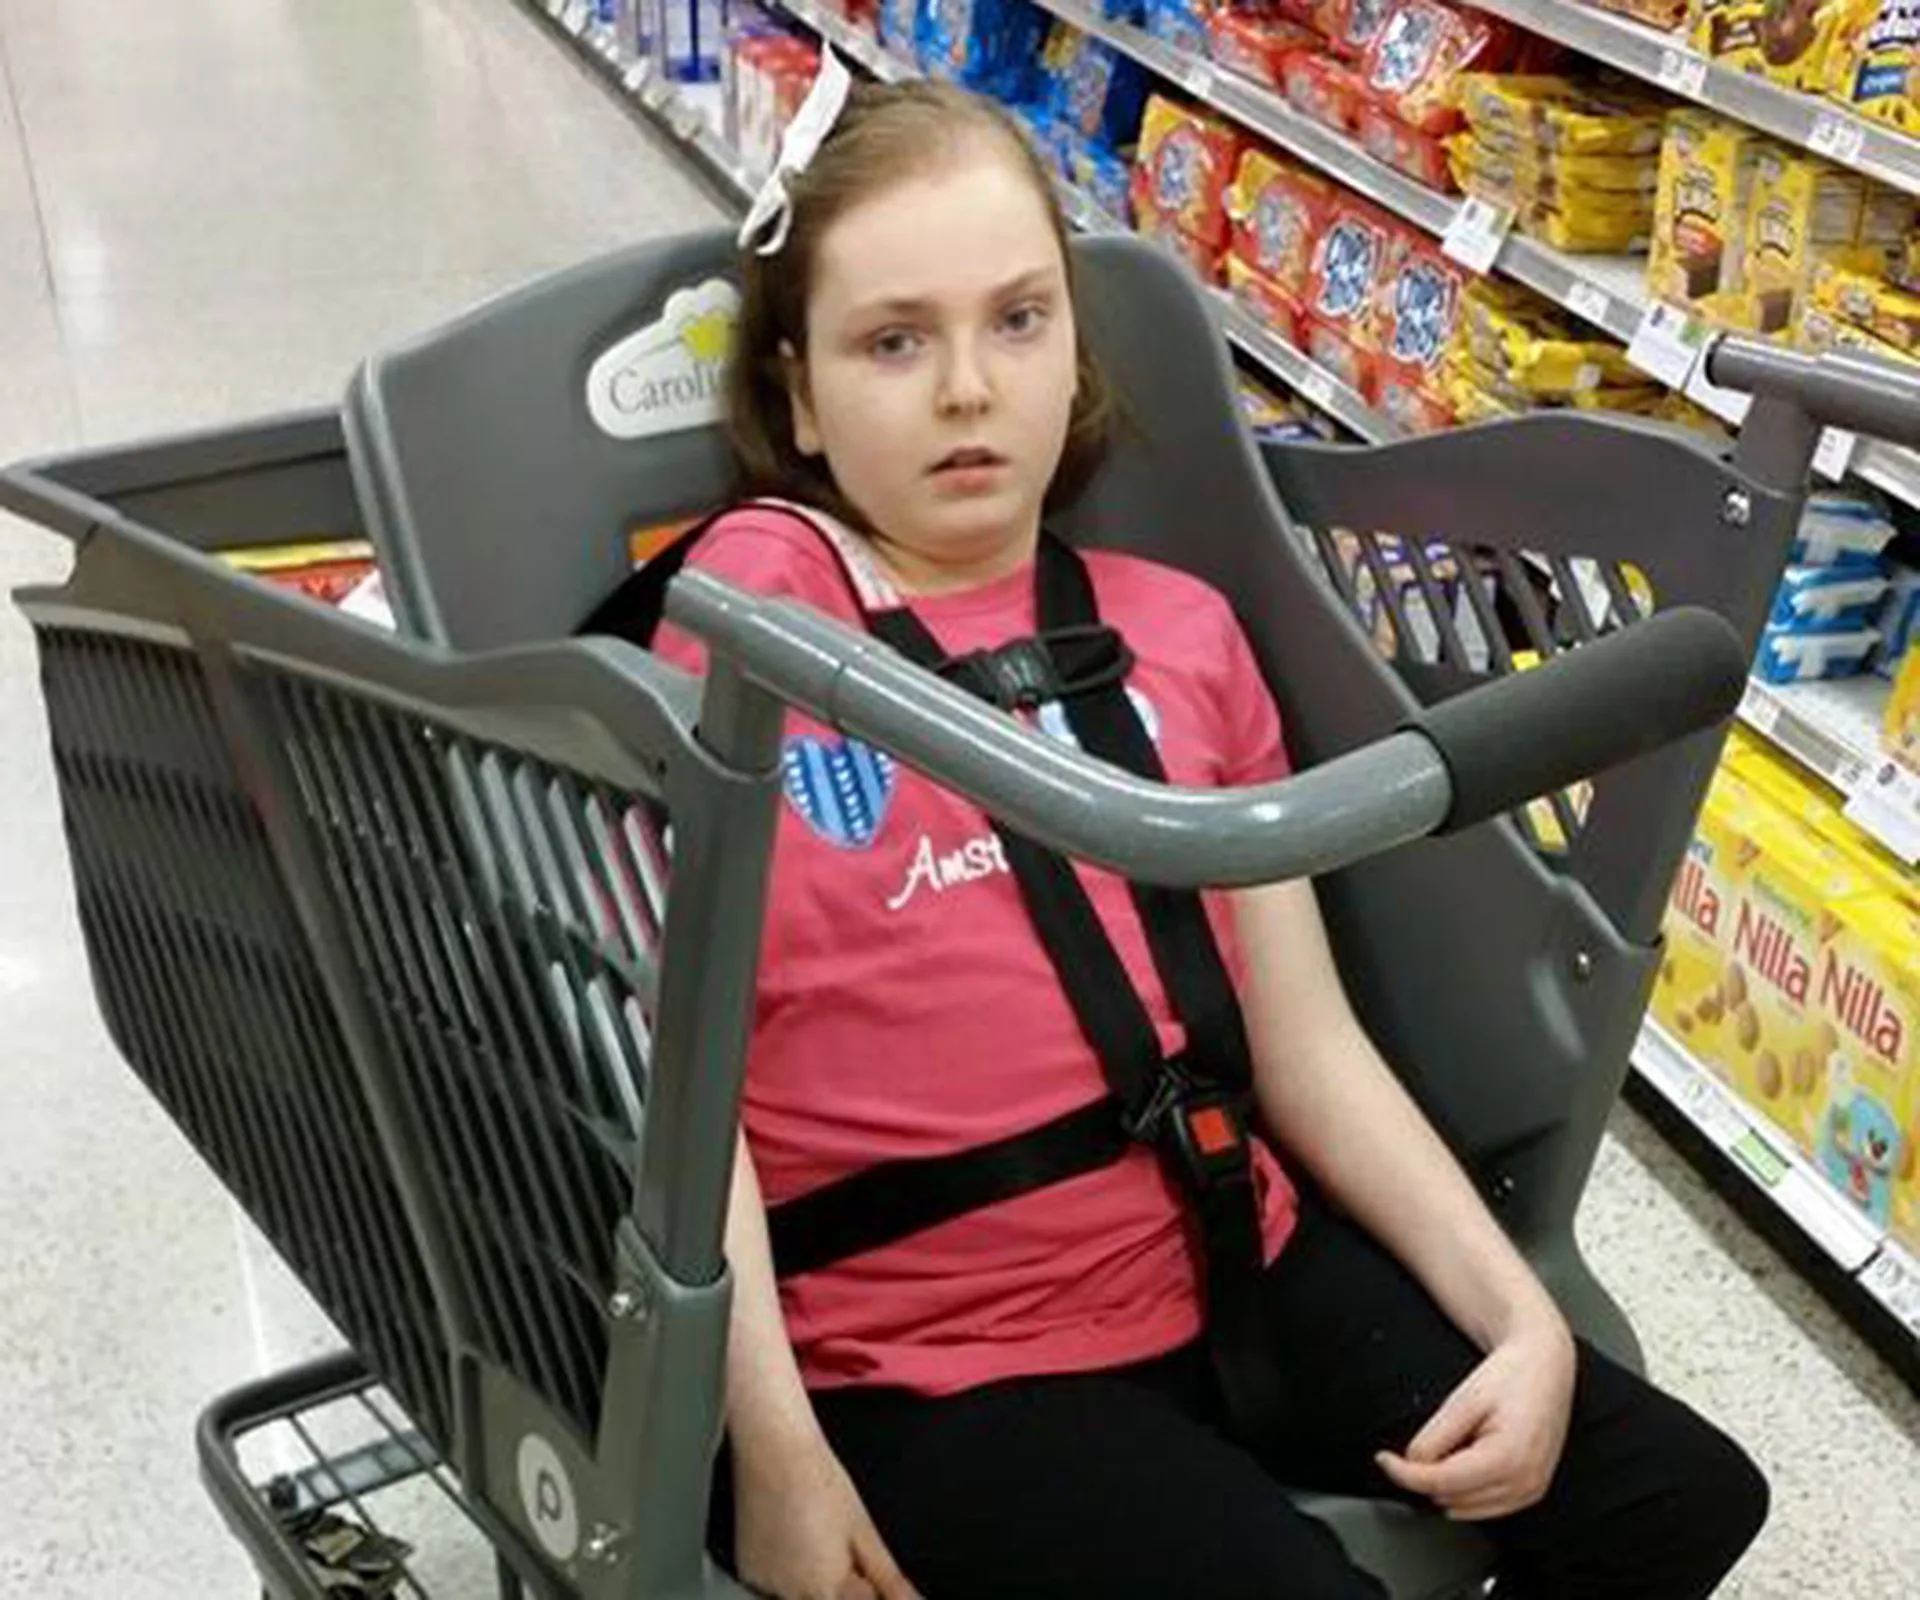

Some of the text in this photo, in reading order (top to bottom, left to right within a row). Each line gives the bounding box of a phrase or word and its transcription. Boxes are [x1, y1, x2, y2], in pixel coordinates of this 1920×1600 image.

[608, 360, 728, 414] Caroli
[886, 832, 1008, 910] Amst
[1735, 897, 1810, 1006] Nilla
[1820, 946, 1902, 1065] Nilla
